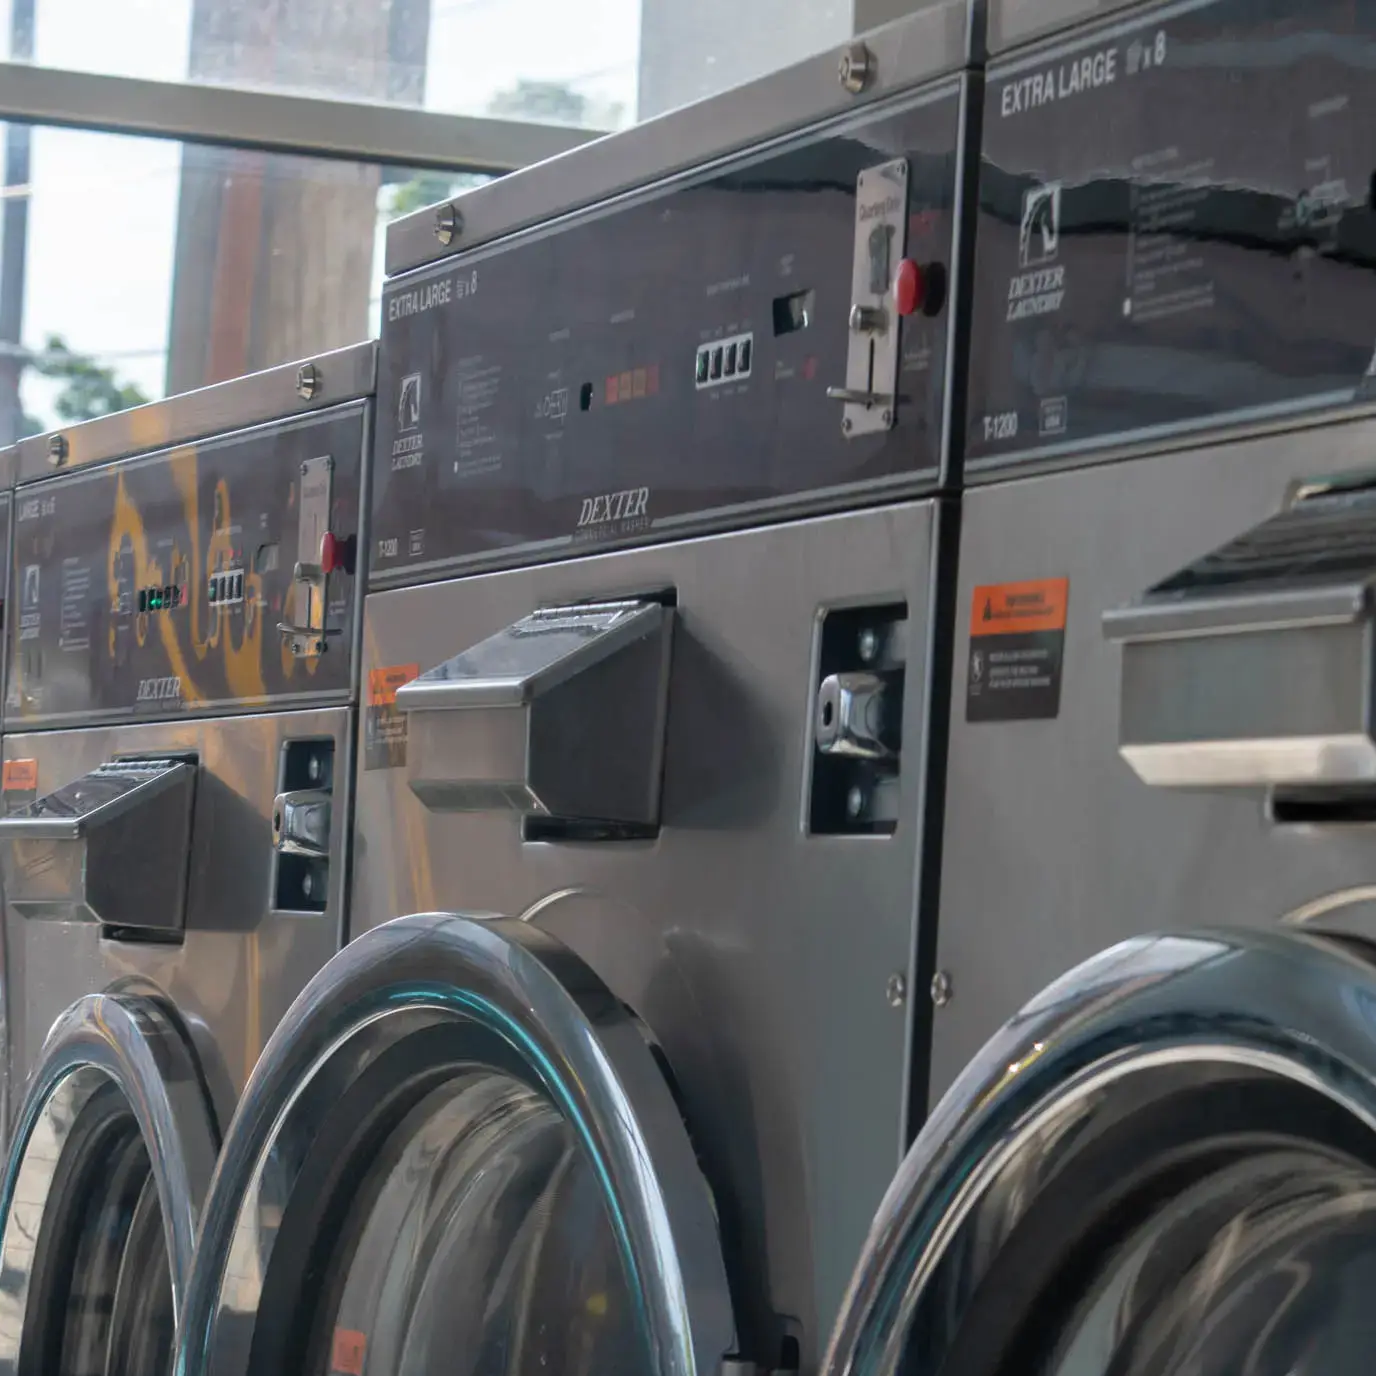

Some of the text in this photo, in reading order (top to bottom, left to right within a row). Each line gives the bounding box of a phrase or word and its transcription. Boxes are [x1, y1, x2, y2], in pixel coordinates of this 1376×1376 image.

[1000, 68, 1055, 118] EXTRA
[1057, 47, 1118, 99] LARGE
[388, 291, 419, 322] EXTRA
[419, 279, 452, 313] LARGE
[1007, 264, 1065, 301] DEXTER
[983, 408, 1018, 441] T-1200
[576, 486, 649, 527] DEXTER
[135, 675, 181, 701] DEXTER
